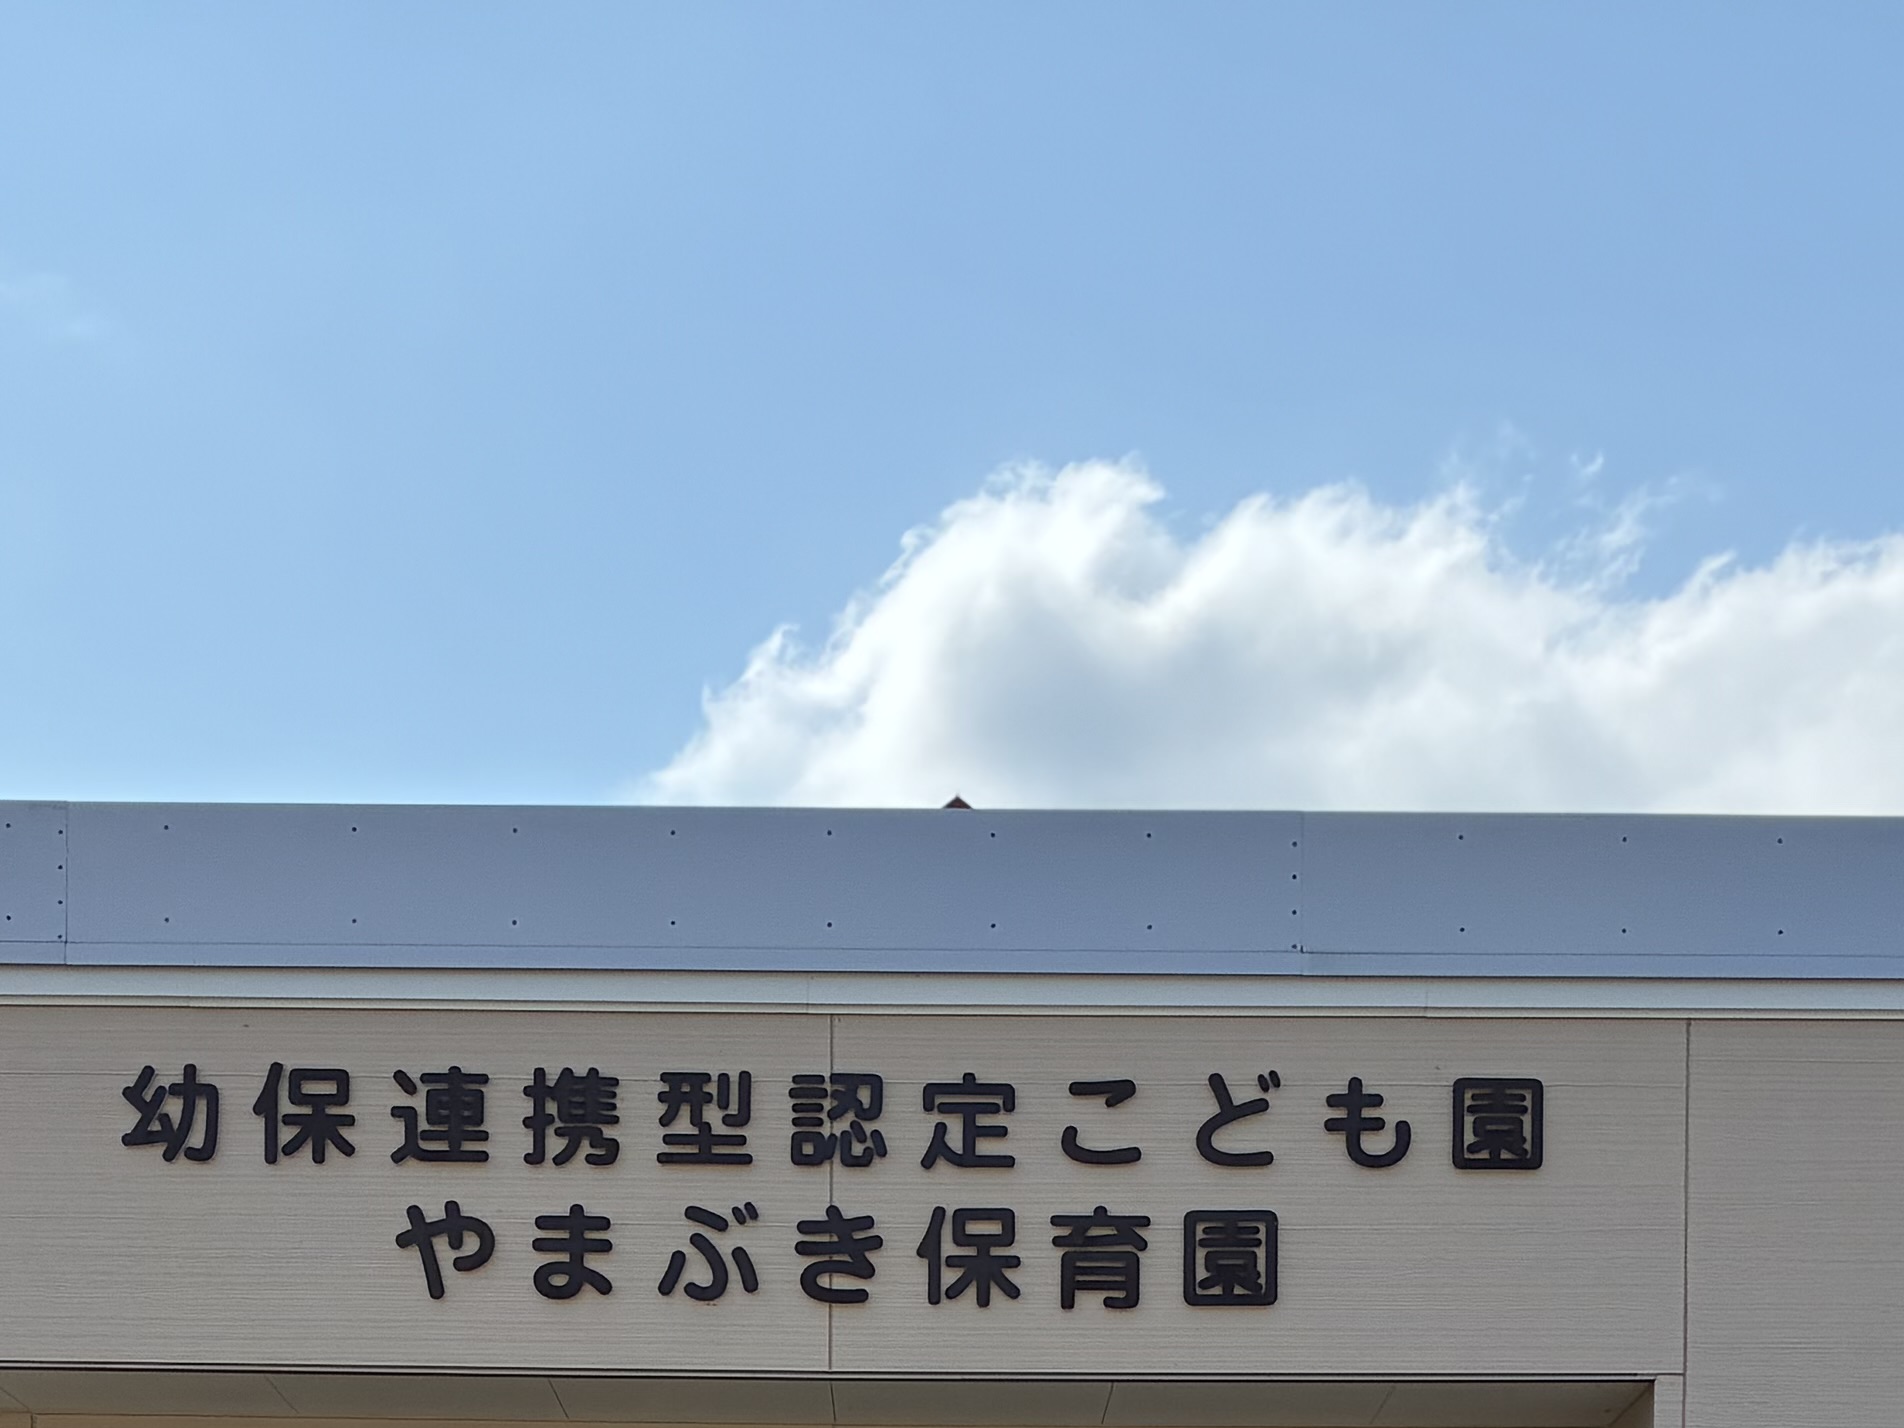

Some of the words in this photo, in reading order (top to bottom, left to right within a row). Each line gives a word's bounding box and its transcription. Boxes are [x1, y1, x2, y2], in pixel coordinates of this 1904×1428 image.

[121, 1063, 1545, 1172] 幼保連携型認定こども園
[394, 1201, 1280, 1310] やまぶき保育園
